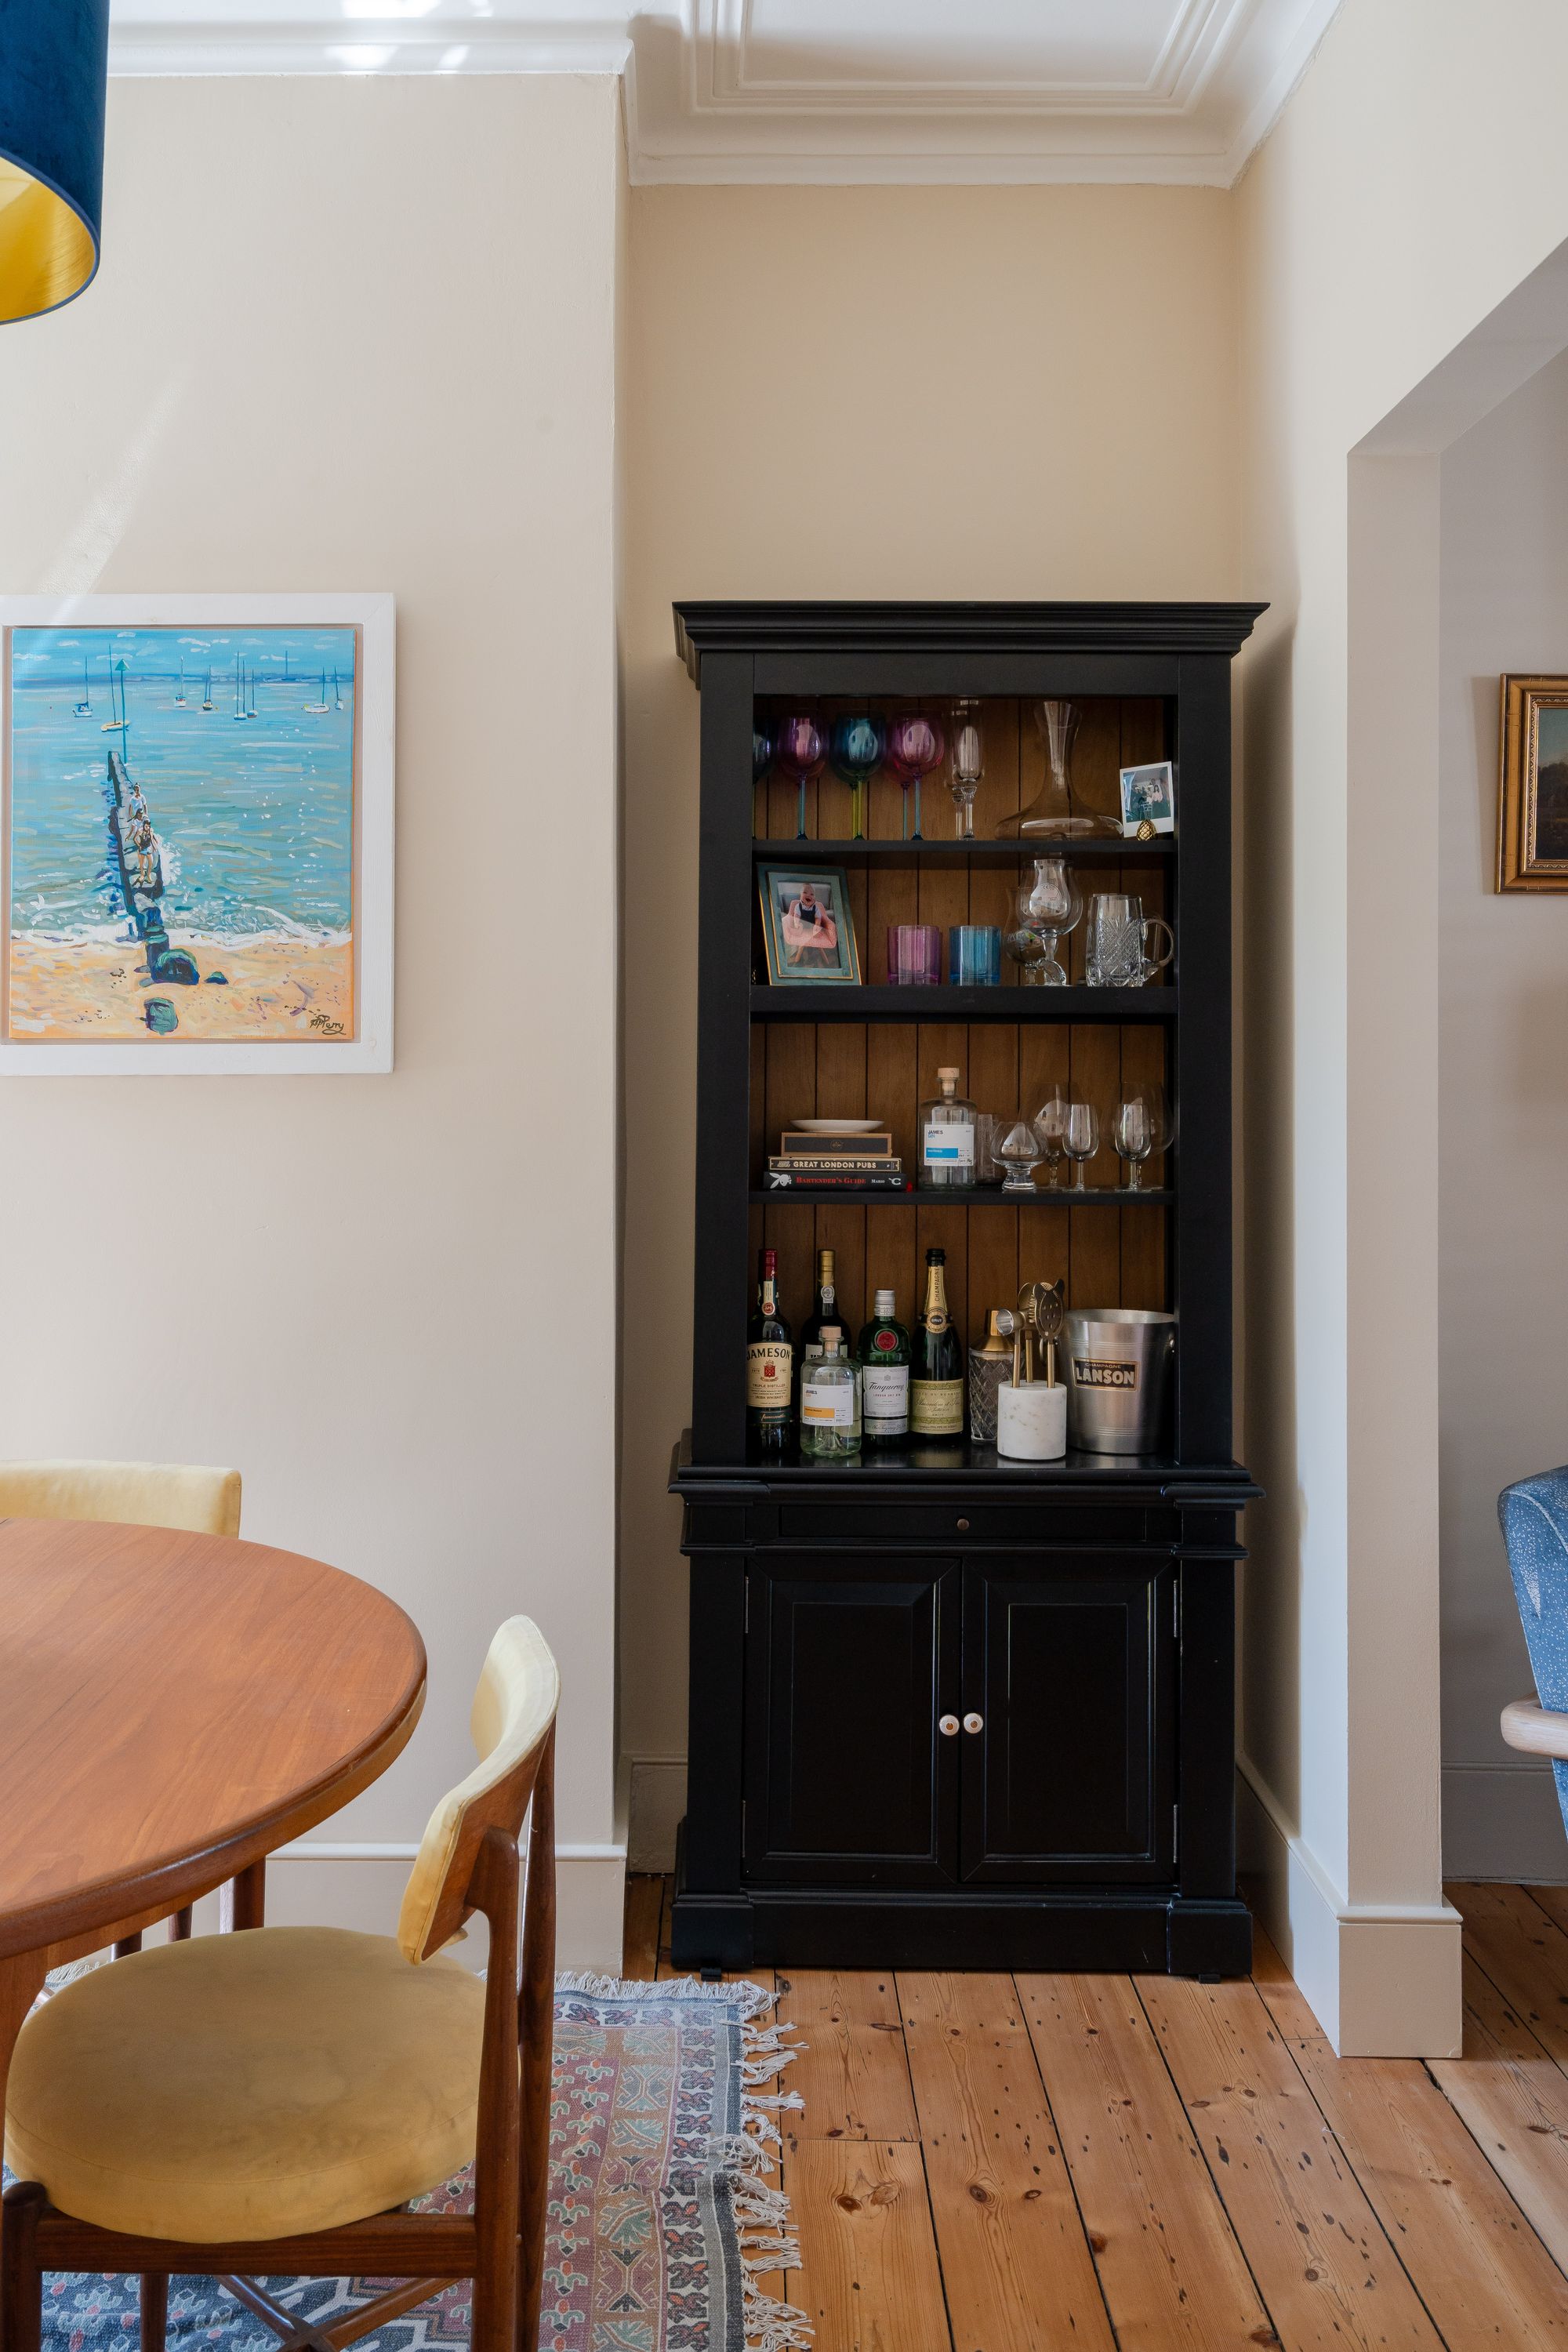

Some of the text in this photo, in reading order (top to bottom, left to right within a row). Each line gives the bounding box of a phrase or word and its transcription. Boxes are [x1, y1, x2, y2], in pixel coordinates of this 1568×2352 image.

[746, 1348, 790, 1361] JAMESON
[1076, 1367, 1134, 1384] LANSON
[869, 1381, 905, 1392] Tanqueray
